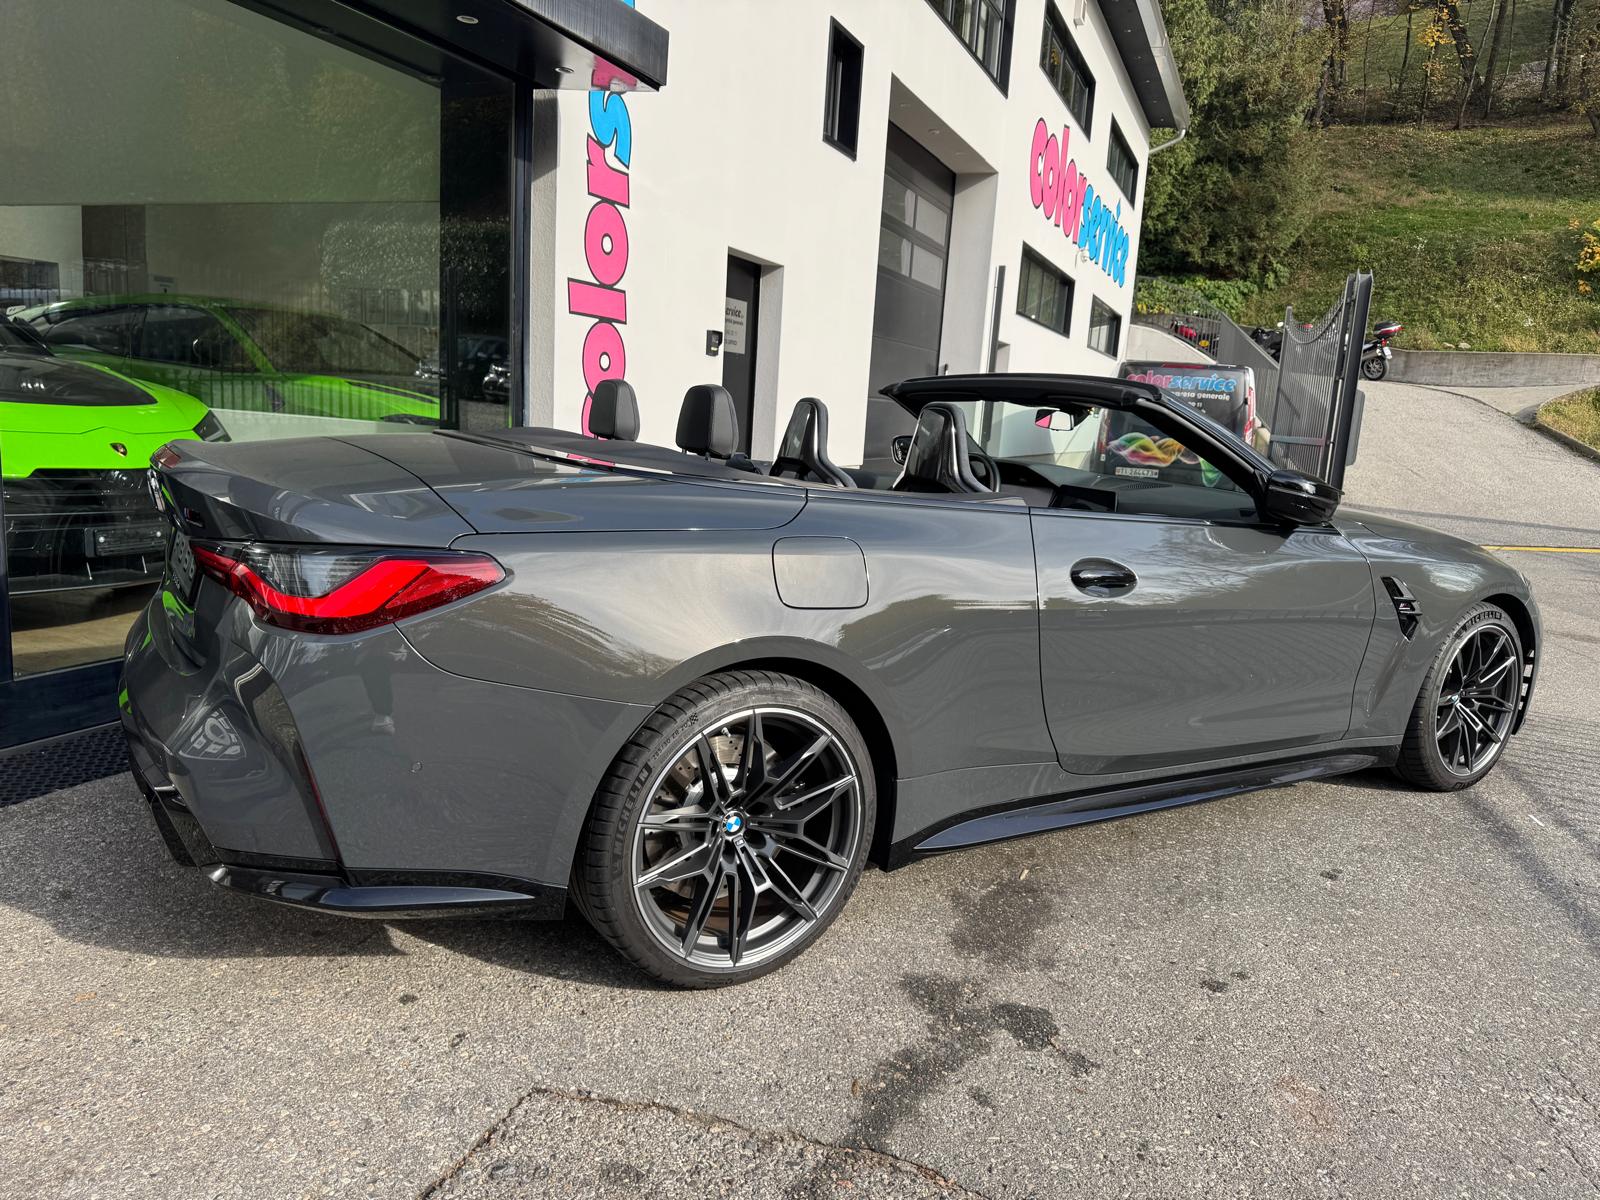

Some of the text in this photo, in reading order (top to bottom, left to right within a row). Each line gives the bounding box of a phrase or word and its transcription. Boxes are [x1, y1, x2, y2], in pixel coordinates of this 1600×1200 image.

[1029, 117, 1130, 288] colorservice
[725, 306, 742, 318] ervice
[1197, 393, 1231, 401] generale
[612, 764, 653, 857] MICHELIN
